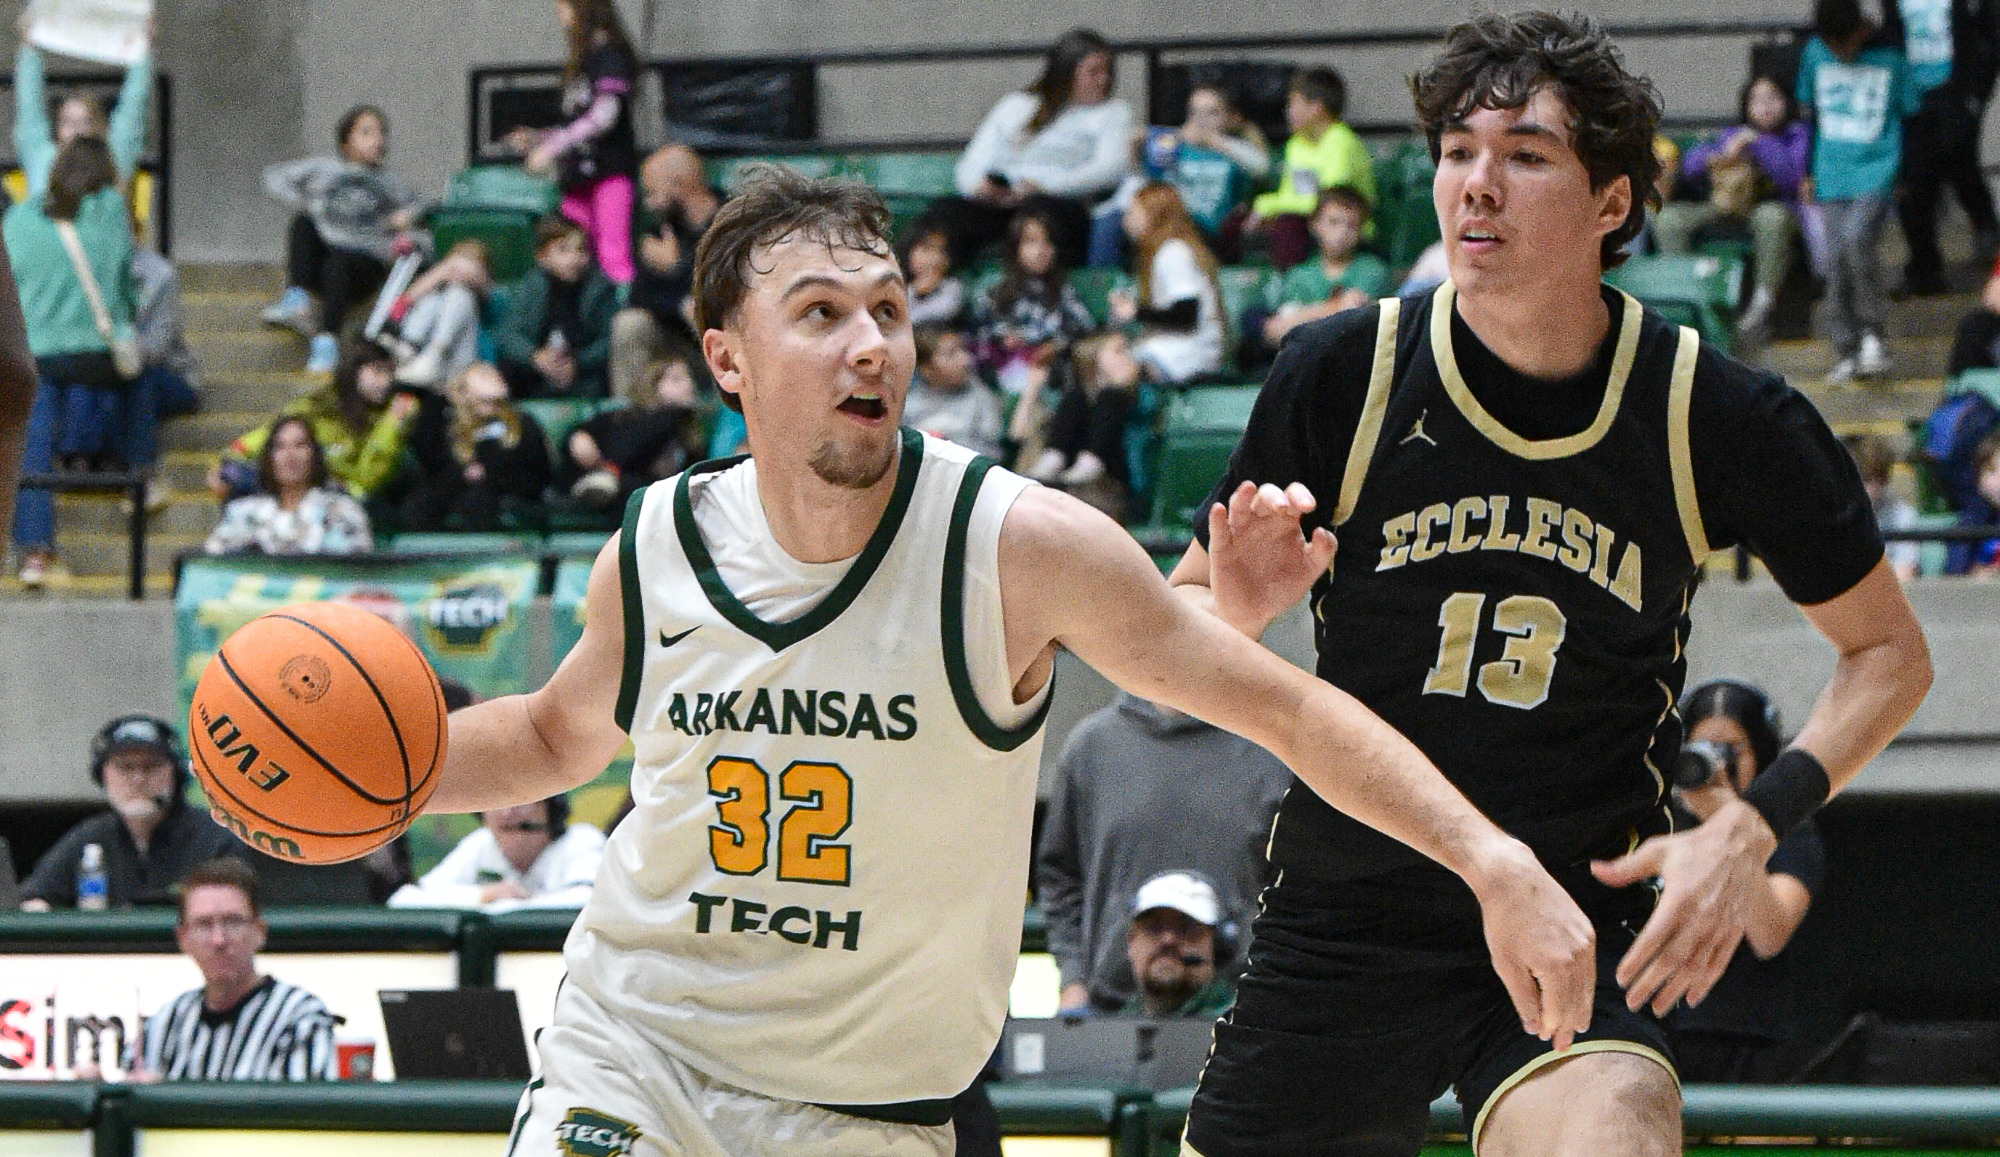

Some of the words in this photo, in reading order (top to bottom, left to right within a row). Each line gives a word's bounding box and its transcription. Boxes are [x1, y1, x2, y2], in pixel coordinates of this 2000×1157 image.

[1375, 495, 1642, 613] ECCLESIA
[429, 597, 508, 627] TECH
[1422, 592, 1567, 710] 13
[667, 688, 918, 741] ARKANSAS
[207, 713, 291, 793] EVO
[706, 755, 853, 888] 32
[688, 892, 862, 951] TECH
[556, 1122, 633, 1153] TECH
